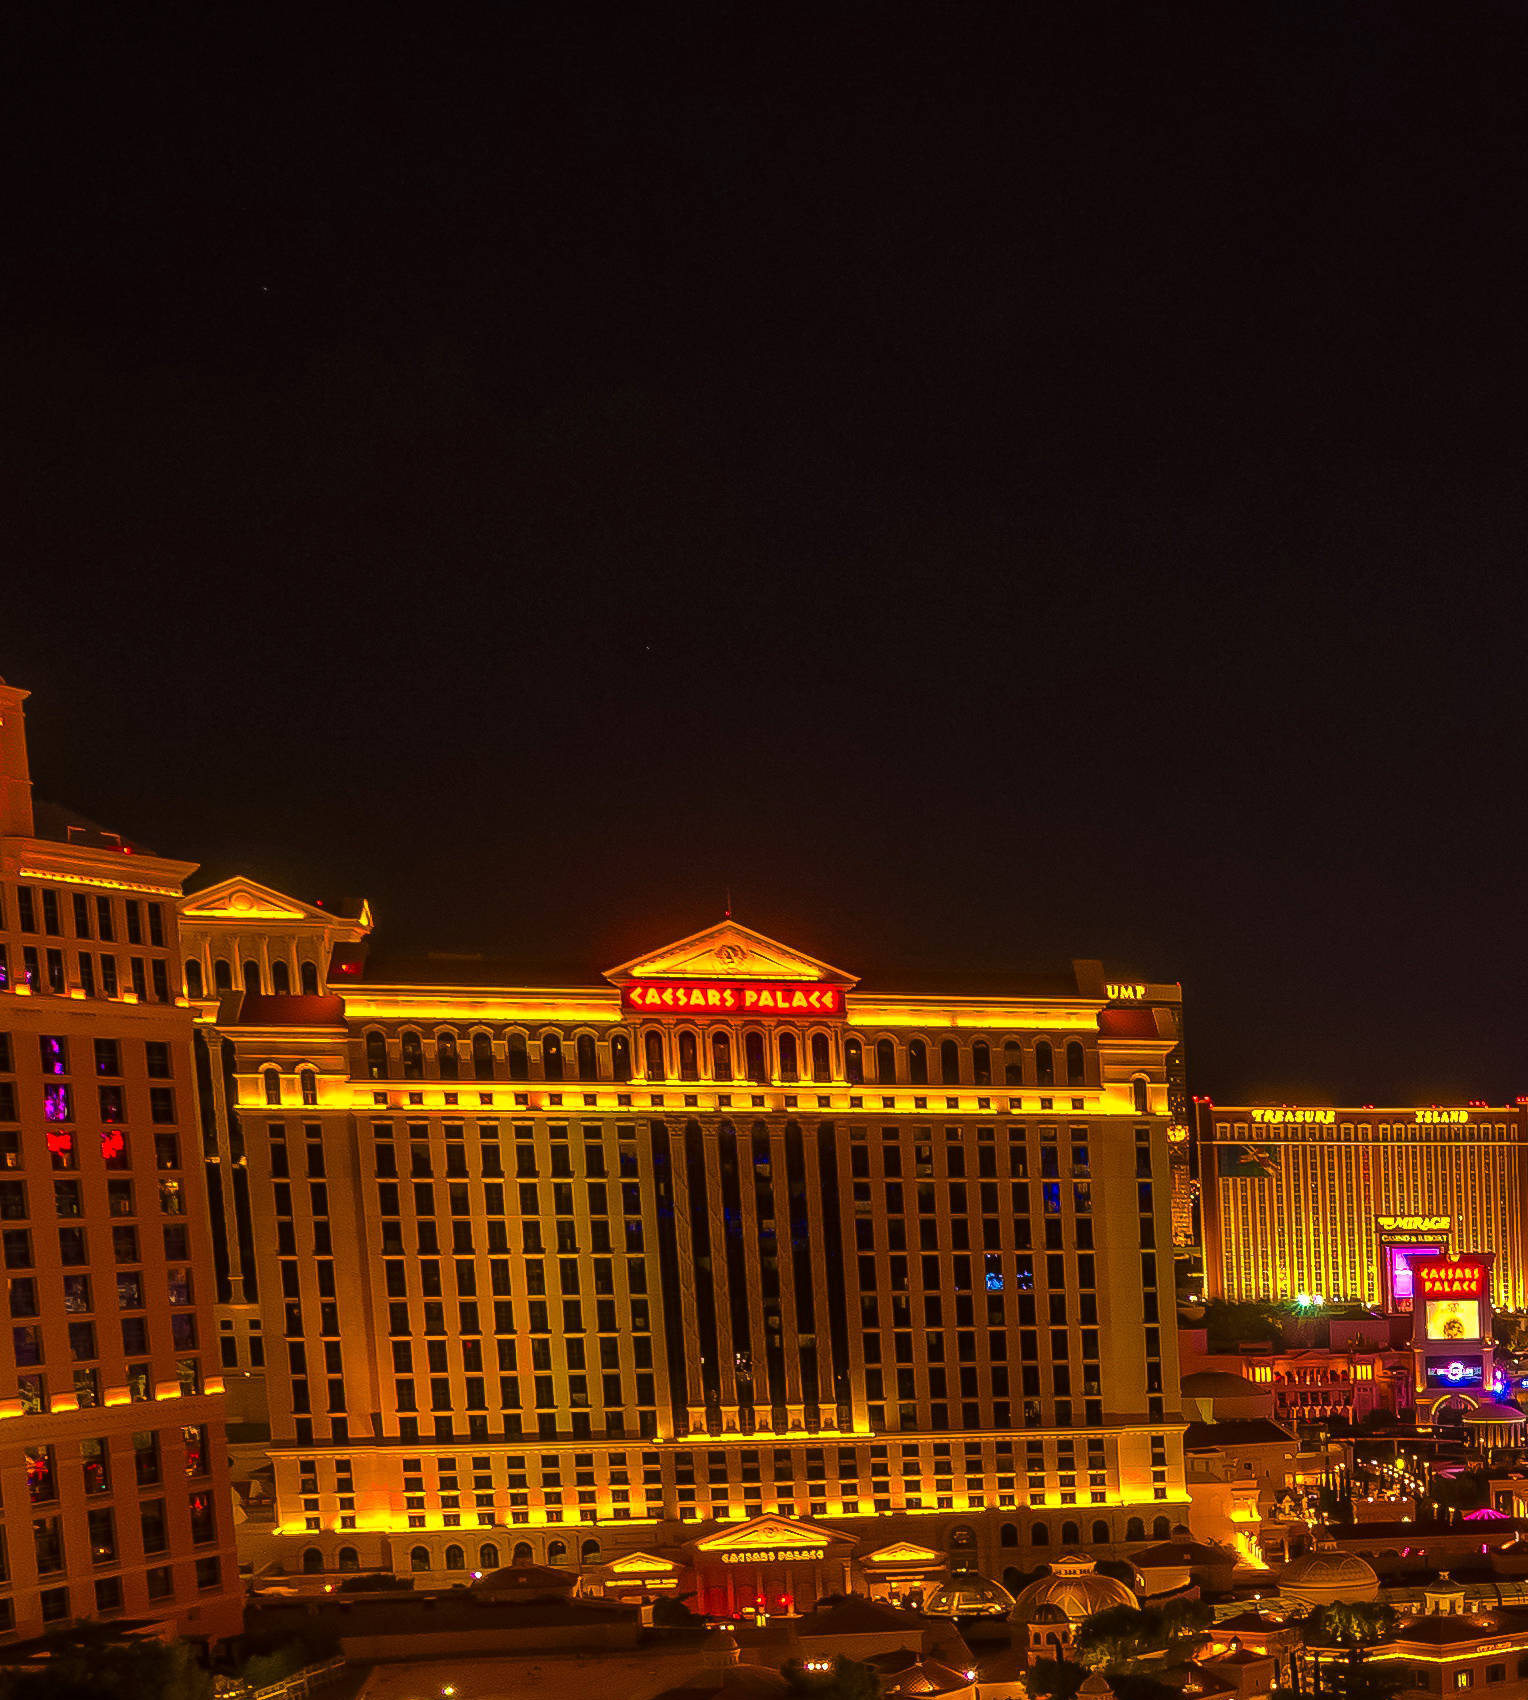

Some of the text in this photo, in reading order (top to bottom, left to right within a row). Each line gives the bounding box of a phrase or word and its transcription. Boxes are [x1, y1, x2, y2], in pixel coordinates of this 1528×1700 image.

[630, 987, 834, 1008] CAESARS PALACE
[1252, 1109, 1469, 1124] TREASURE ISLAND
[1395, 1216, 1451, 1230] MIRAGE
[1420, 1267, 1480, 1280] CAESARS
[1424, 1280, 1478, 1292] PALACE
